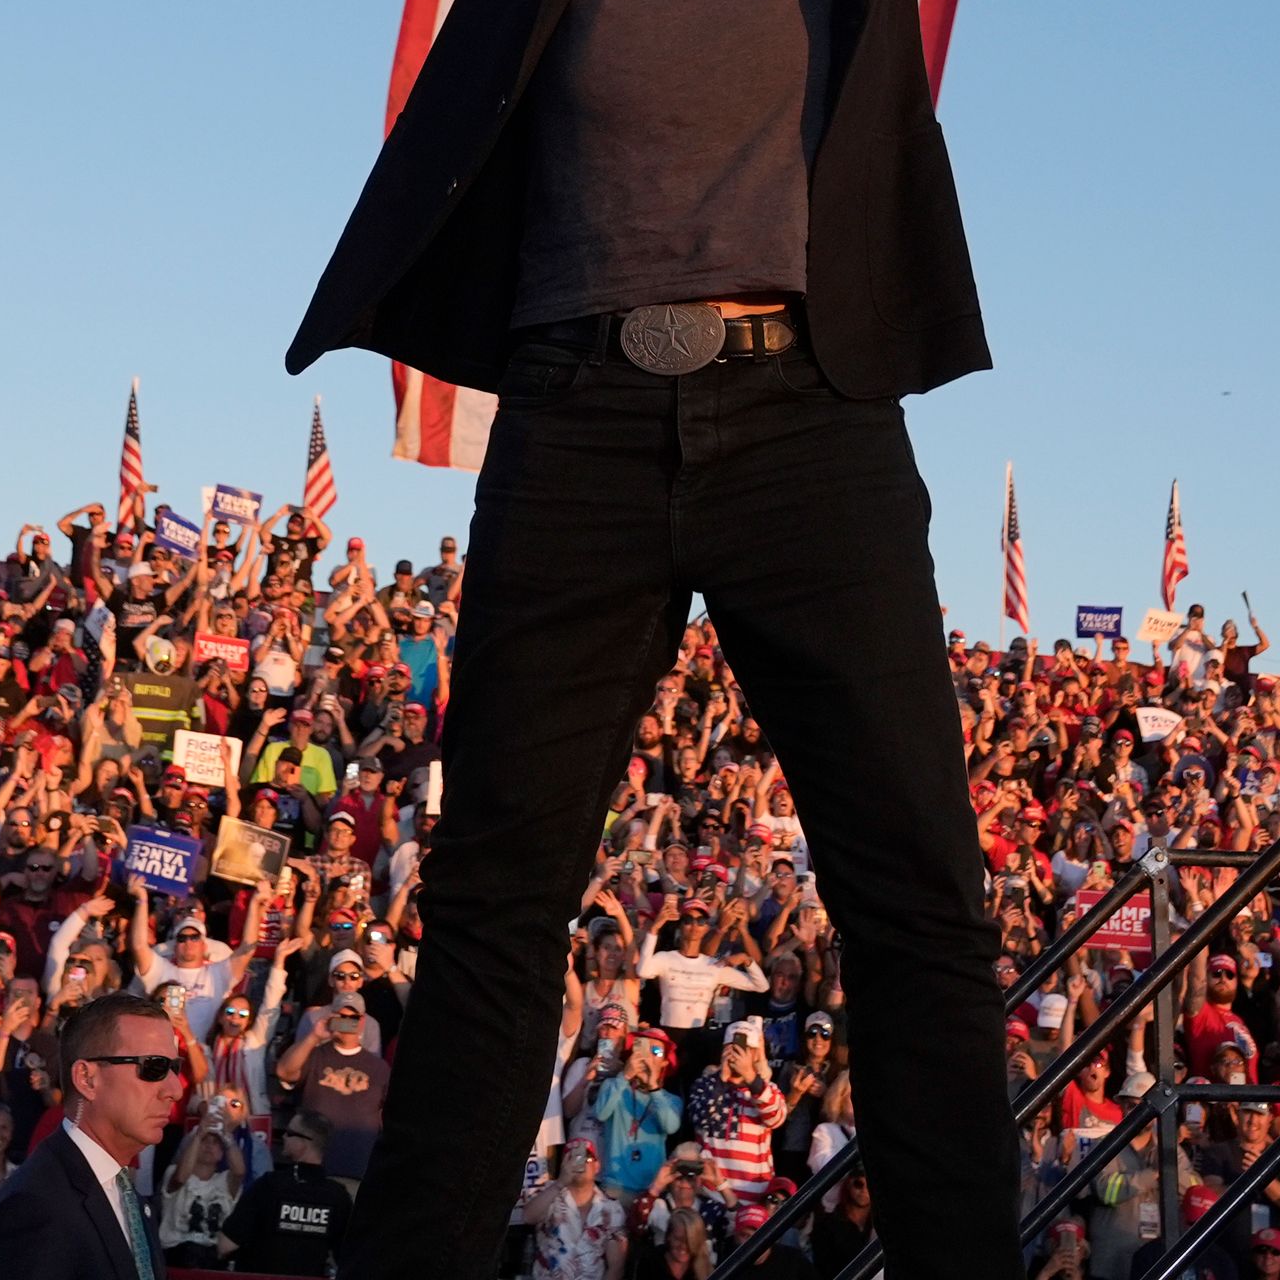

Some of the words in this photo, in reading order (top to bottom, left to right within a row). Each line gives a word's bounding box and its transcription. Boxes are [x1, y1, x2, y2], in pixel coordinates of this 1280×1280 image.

[131, 844, 184, 867] VANCE
[1100, 920, 1143, 932] ANCE
[280, 1204, 330, 1224] POLICE
